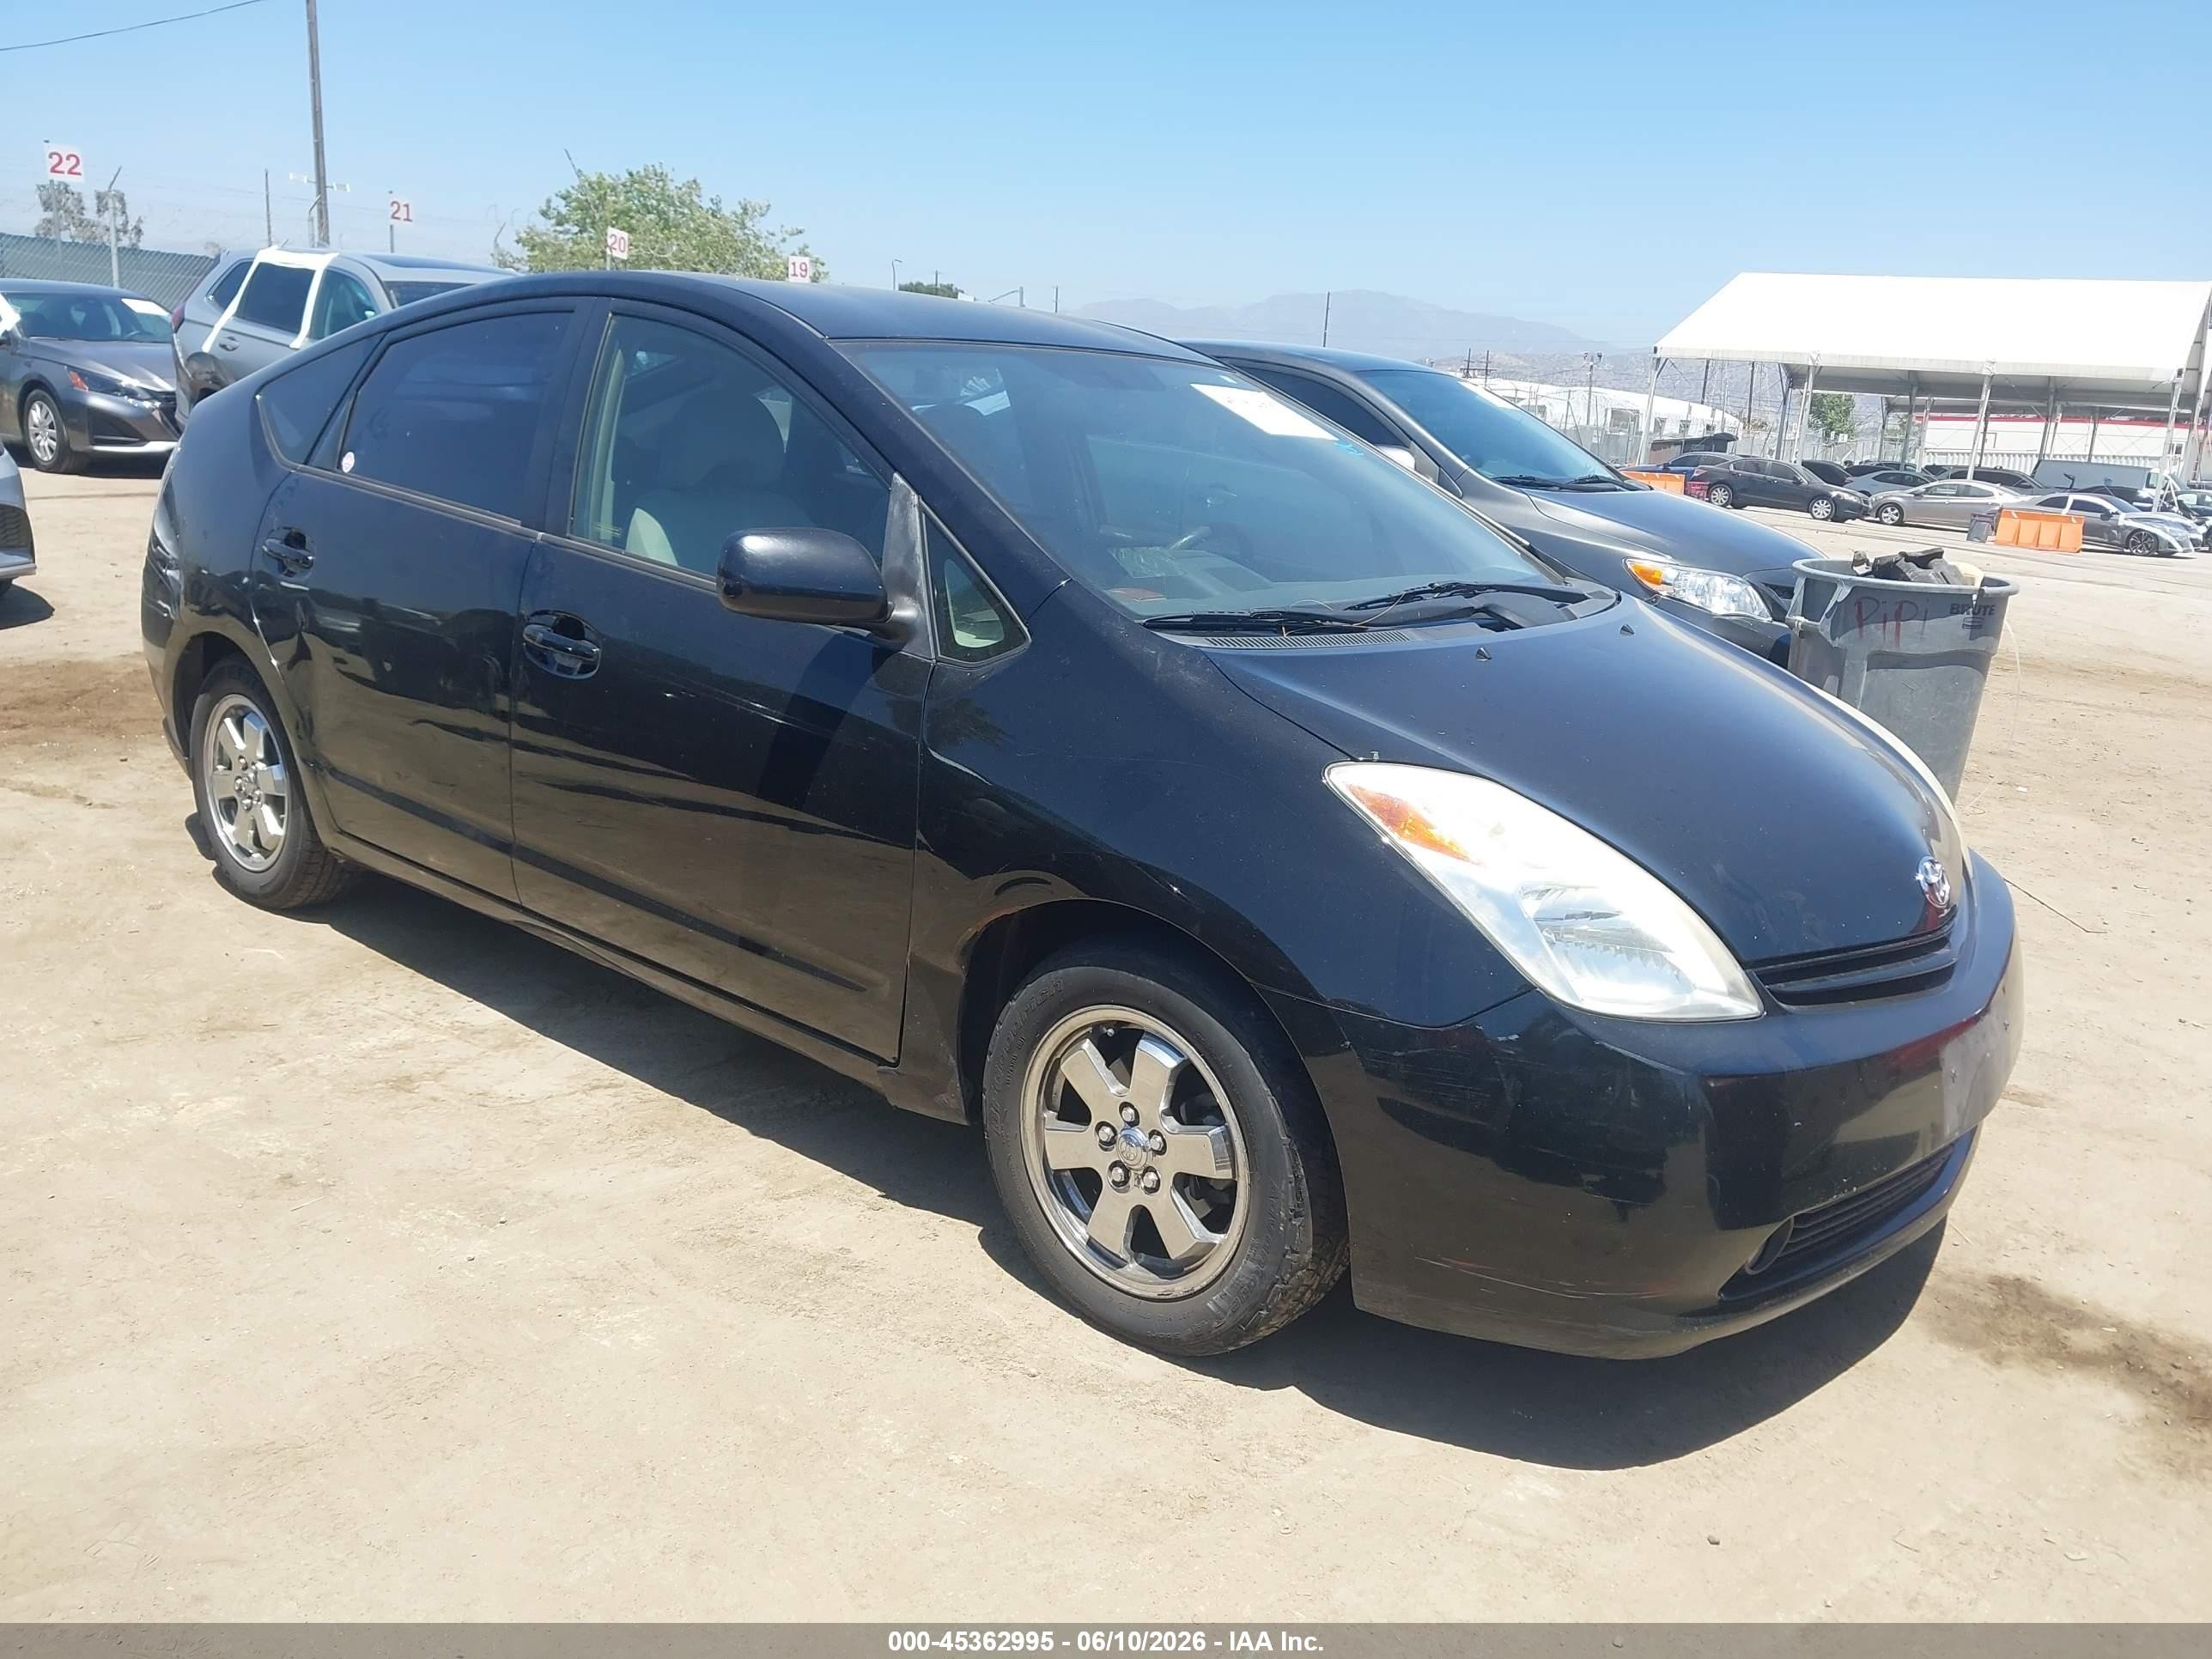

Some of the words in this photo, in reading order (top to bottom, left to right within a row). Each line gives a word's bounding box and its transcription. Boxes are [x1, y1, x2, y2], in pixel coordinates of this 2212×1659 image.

[48, 151, 82, 176] 22
[391, 200, 413, 222] 21
[609, 233, 626, 253] 20
[790, 260, 808, 278] 19
